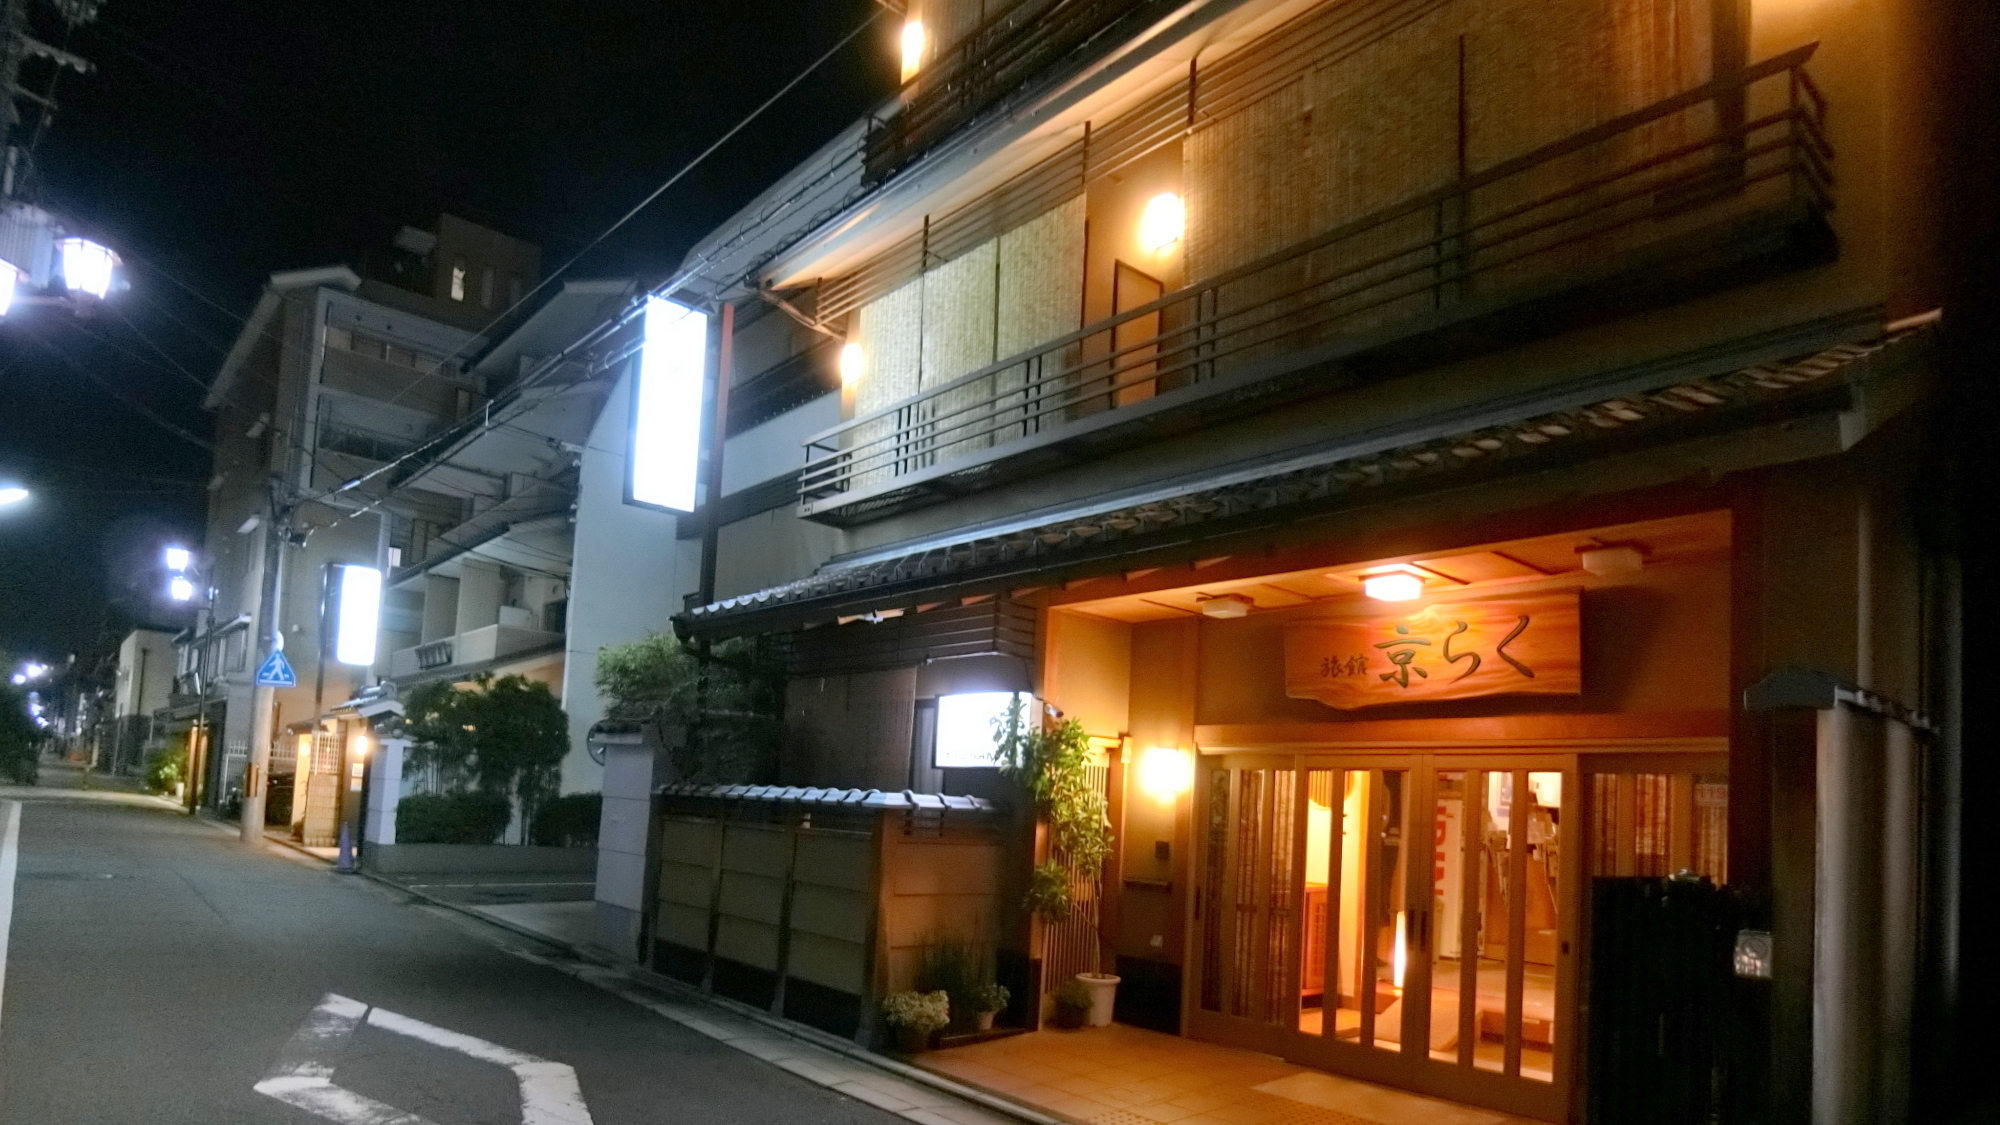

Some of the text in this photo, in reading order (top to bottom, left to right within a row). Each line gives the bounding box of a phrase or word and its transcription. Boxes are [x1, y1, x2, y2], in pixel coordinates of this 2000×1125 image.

[1320, 615, 1535, 688] 旅館 京らく
